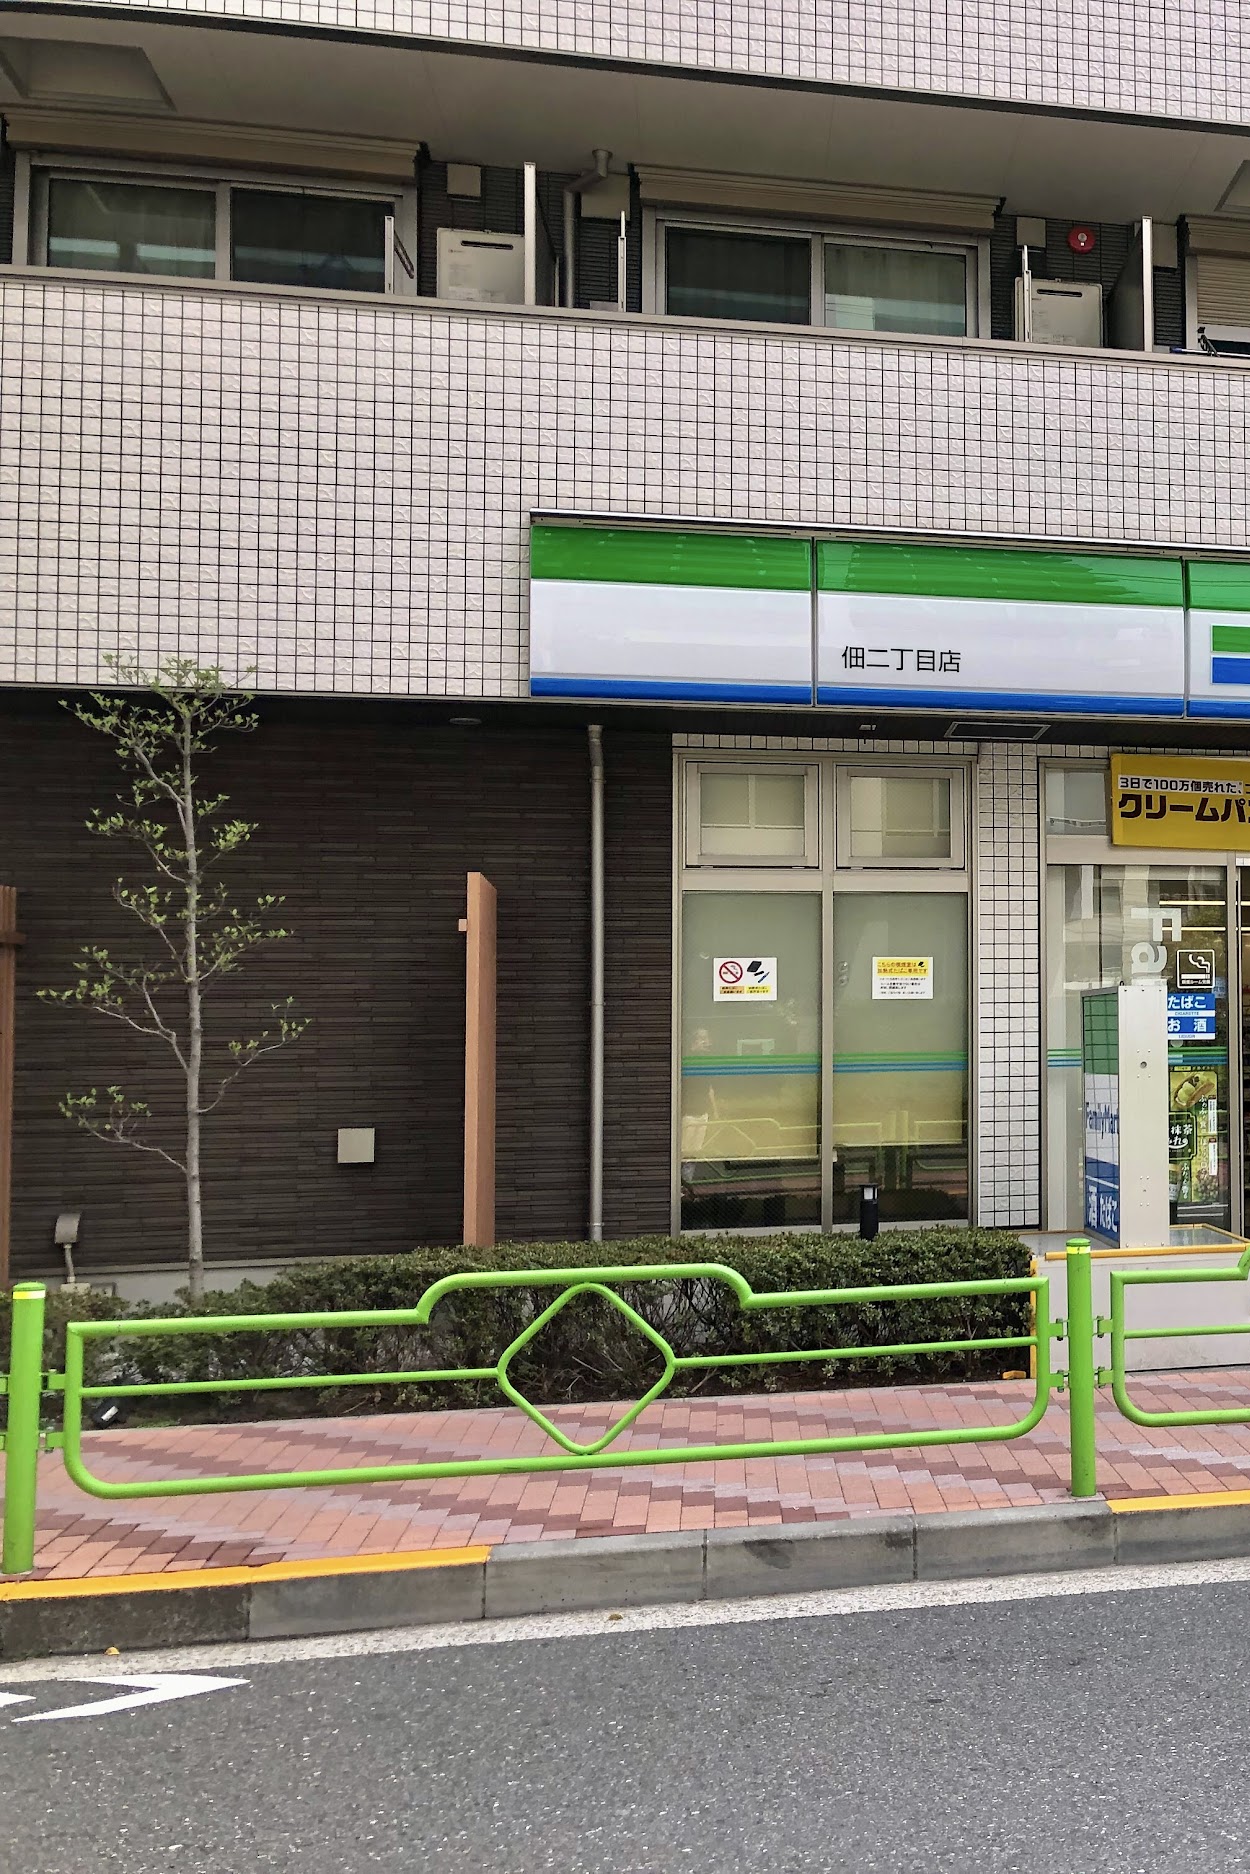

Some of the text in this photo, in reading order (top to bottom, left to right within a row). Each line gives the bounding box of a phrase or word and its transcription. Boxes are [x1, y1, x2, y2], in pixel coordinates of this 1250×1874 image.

[841, 645, 961, 673] 佃二丁目店
[1168, 995, 1207, 1010] たばこ
